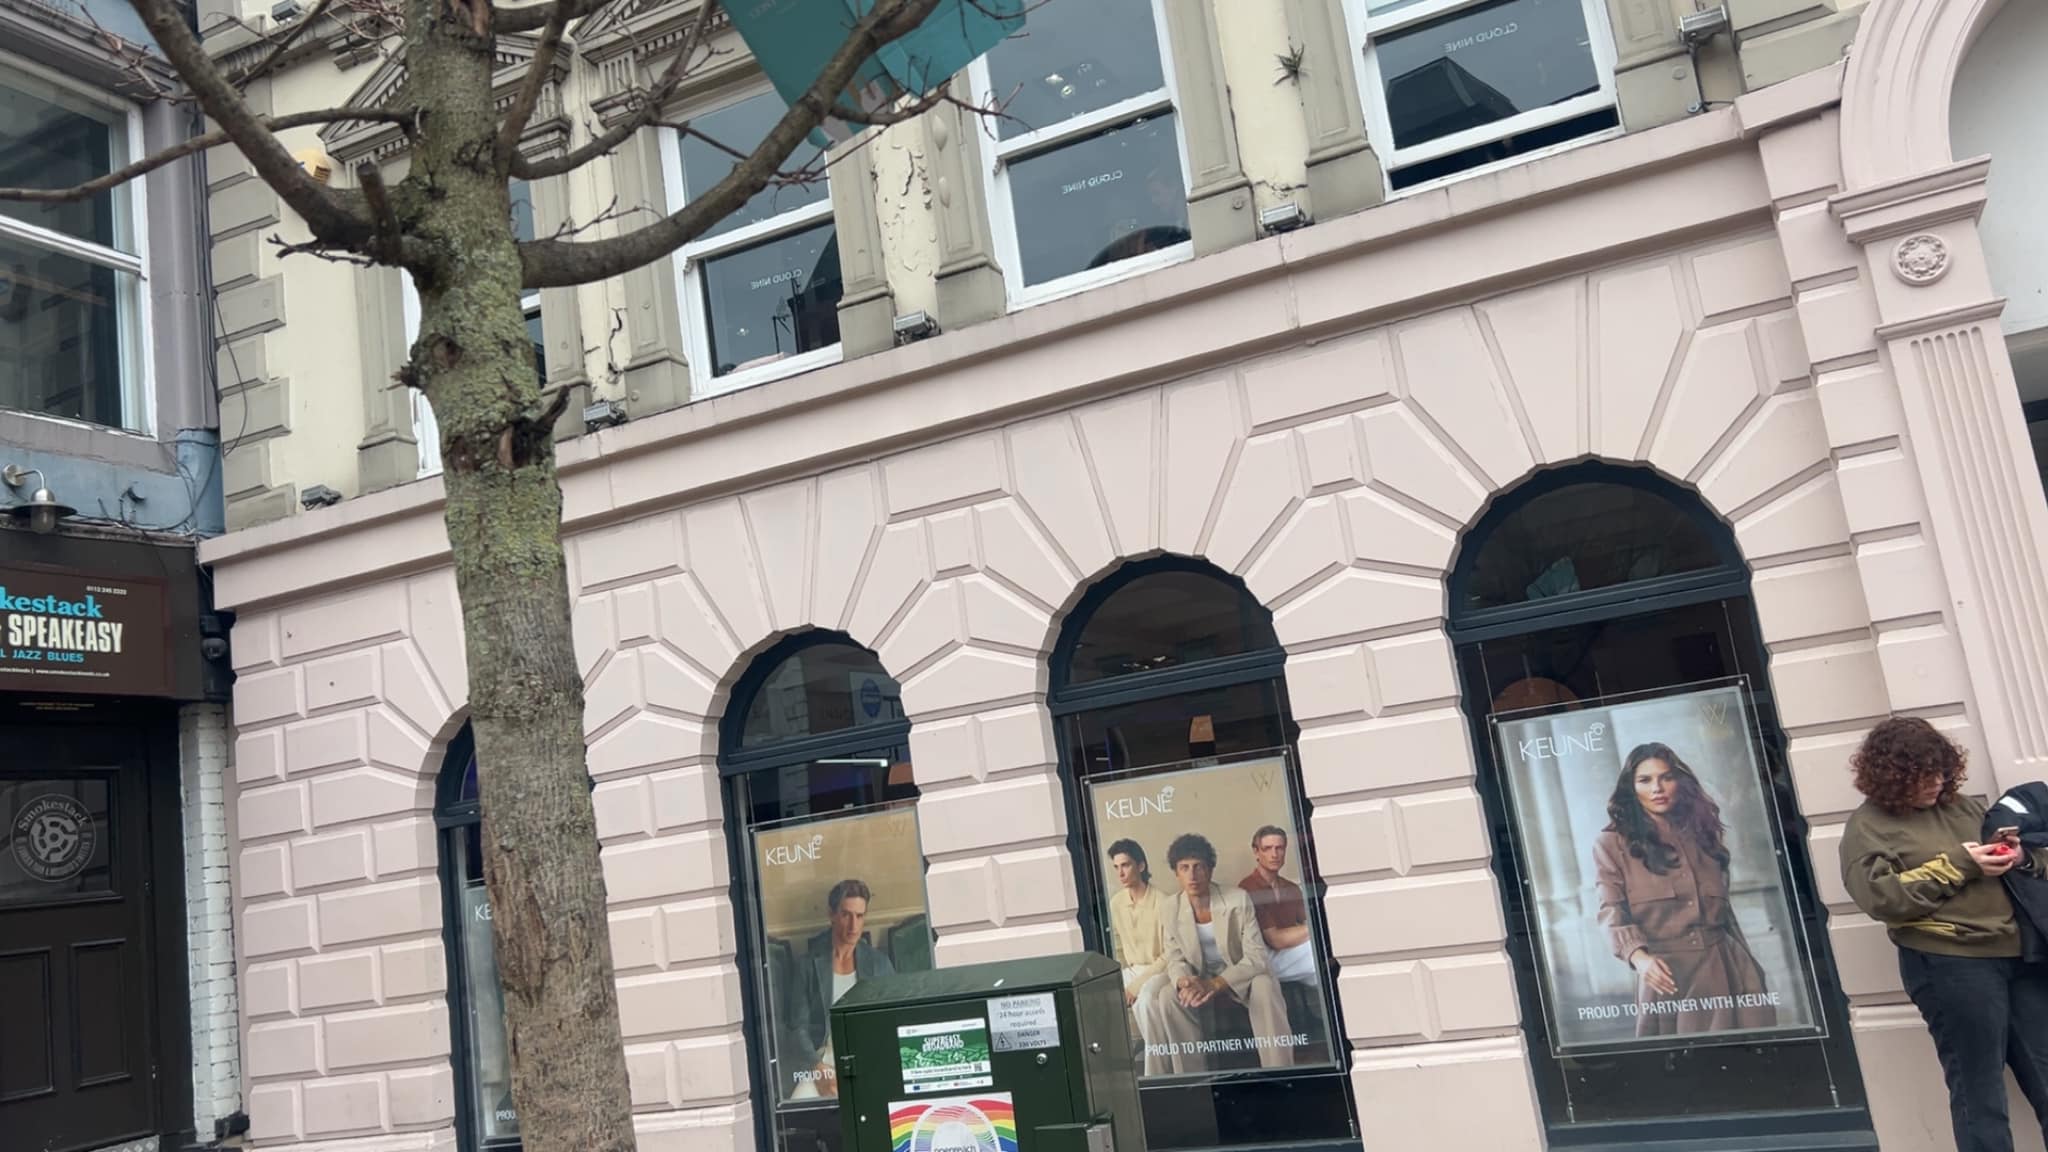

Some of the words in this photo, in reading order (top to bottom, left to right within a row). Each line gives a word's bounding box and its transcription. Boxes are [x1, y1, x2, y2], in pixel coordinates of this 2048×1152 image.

[0, 586, 103, 618] kestack
[8, 613, 123, 653] SPEAKEASY
[12, 649, 42, 660] JAZZ
[47, 651, 85, 663] BLUES
[1518, 729, 1604, 761] KEUNE
[18, 800, 89, 832] Smokestack
[1105, 792, 1173, 820] KEUNE
[765, 840, 822, 866] KEUNE
[1577, 1006, 1620, 1021] PROUD
[1622, 1003, 1638, 1017] TO
[1642, 999, 1698, 1015] PARTNER
[1699, 996, 1733, 1011] WITH
[1736, 992, 1781, 1007] KEUNE
[1145, 1043, 1179, 1057] PROUD
[1181, 1041, 1194, 1054] TO
[1196, 1038, 1241, 1053] PARTNER
[1242, 1036, 1271, 1049] WITH
[1273, 1033, 1309, 1047] KEUNE
[793, 1069, 822, 1082] PROUD
[823, 1068, 834, 1079] TO
[495, 1110, 516, 1121] PROU
